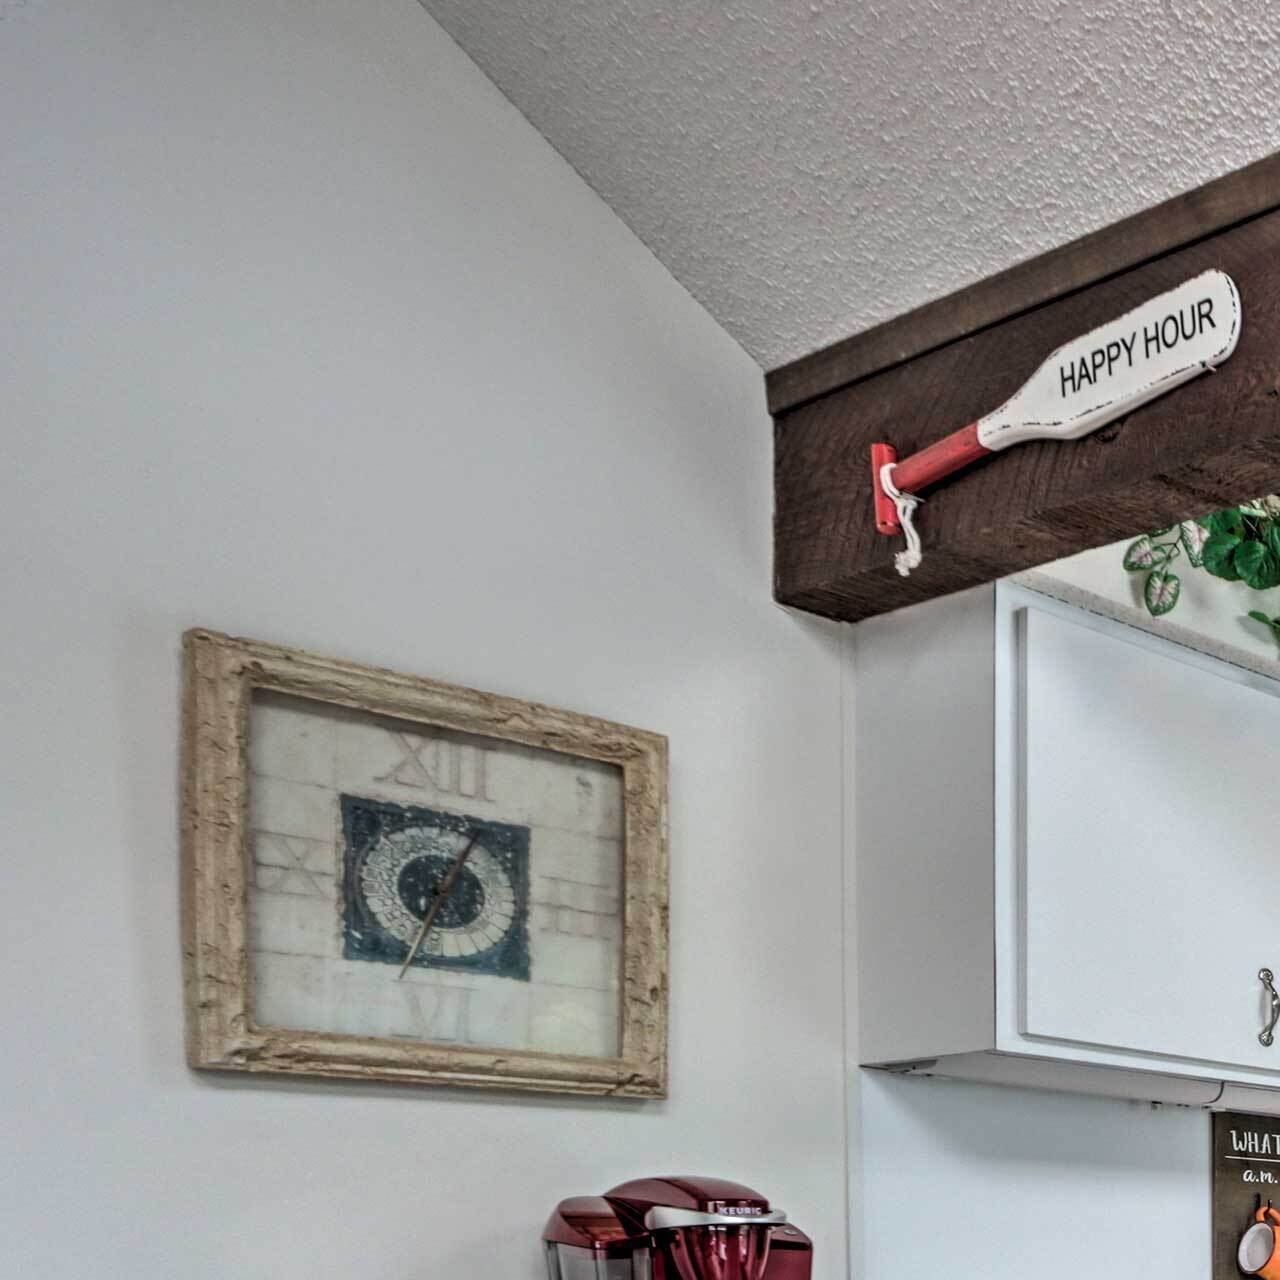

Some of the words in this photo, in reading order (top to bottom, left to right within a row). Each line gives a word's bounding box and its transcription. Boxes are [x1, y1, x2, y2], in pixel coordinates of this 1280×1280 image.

[1060, 332, 1137, 398] HAPPY
[1143, 297, 1217, 359] HOUR
[1242, 1169, 1279, 1184] a.m.
[720, 1207, 762, 1216] KEURIG
